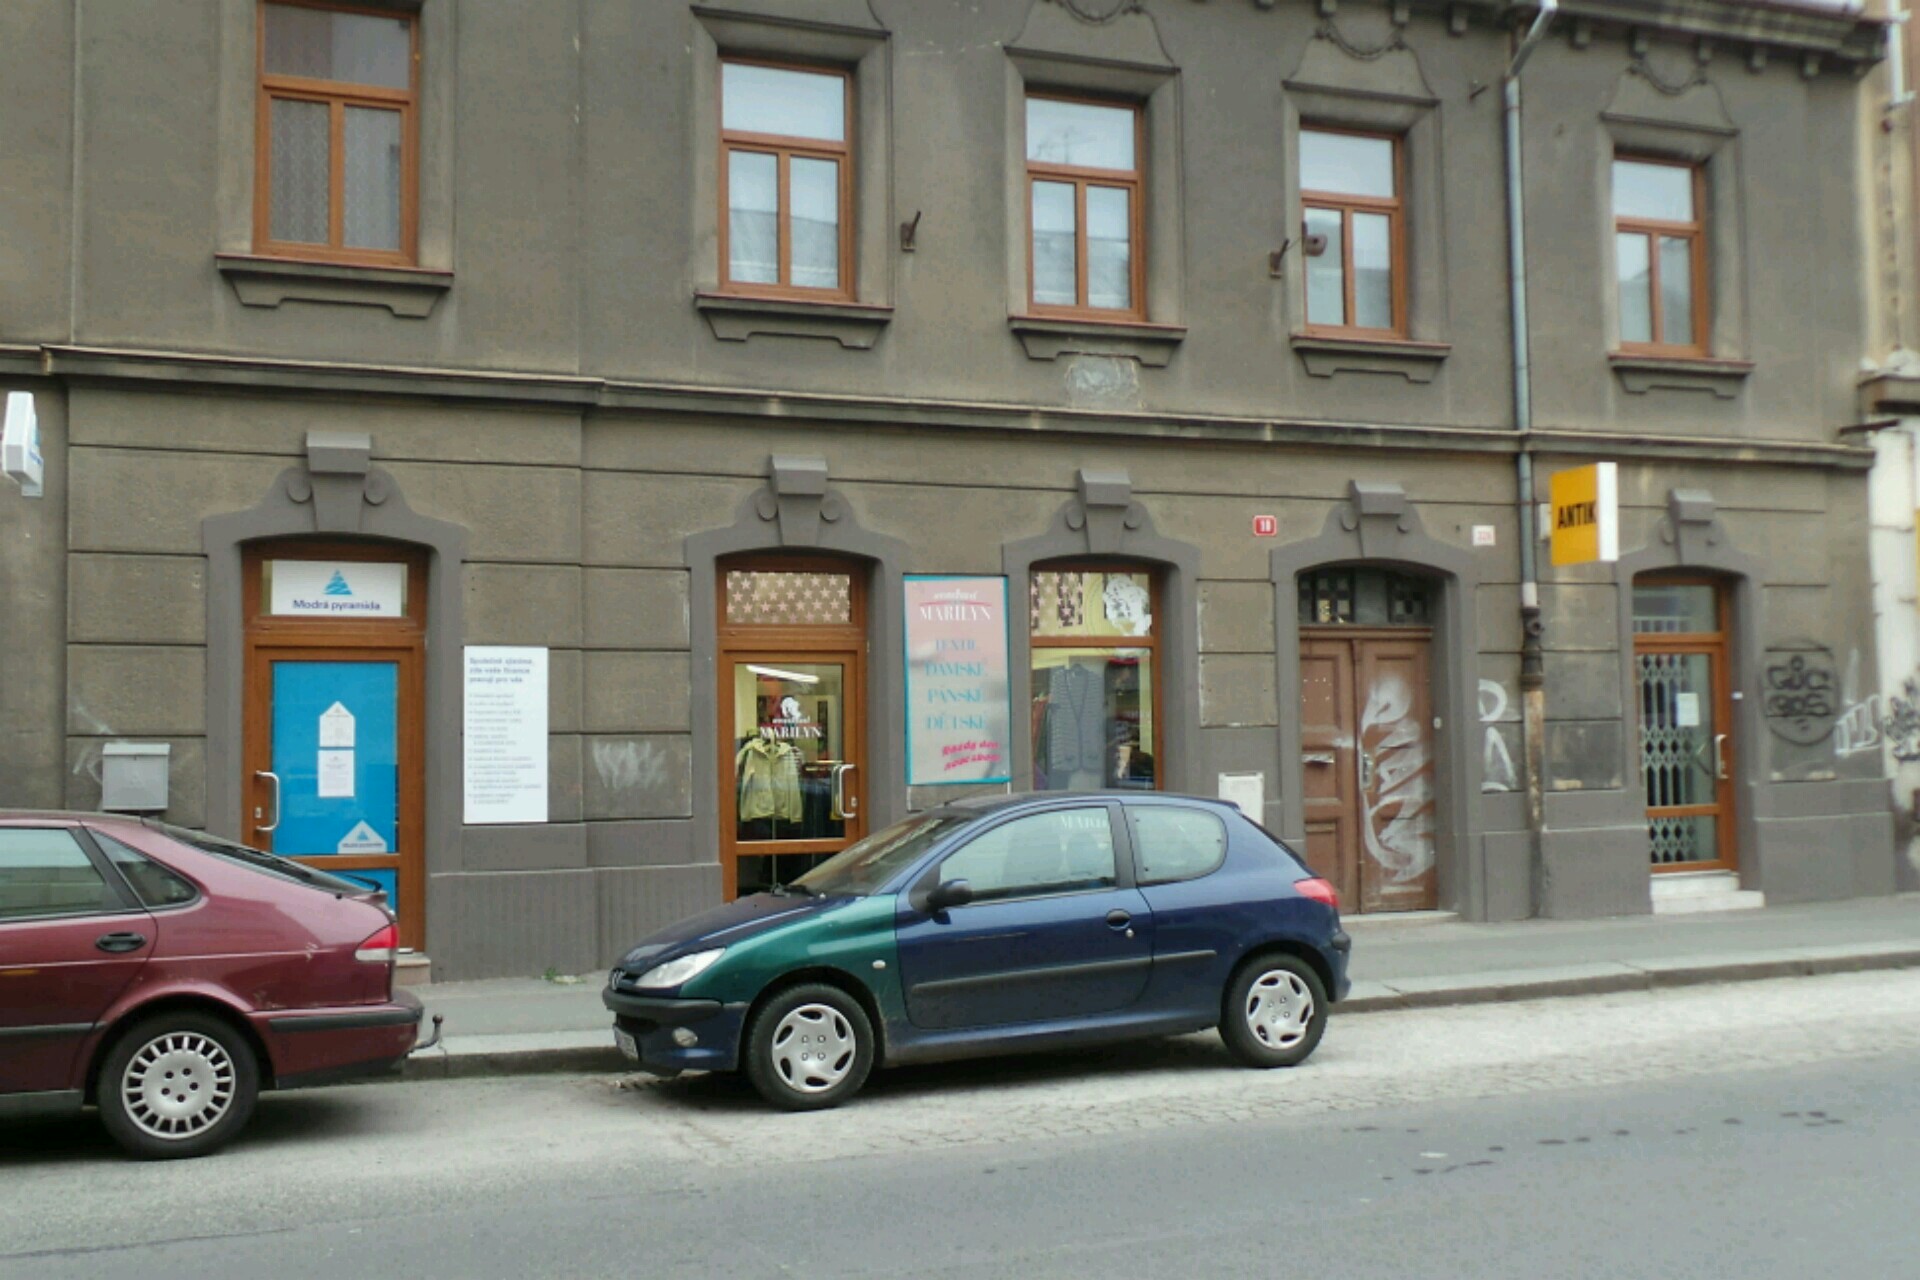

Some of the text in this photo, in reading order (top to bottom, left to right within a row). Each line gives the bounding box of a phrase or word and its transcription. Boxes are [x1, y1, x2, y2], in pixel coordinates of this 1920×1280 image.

[1557, 501, 1597, 530] ANTIK
[293, 599, 381, 612] Modrá pyramida
[919, 604, 992, 621] MARILYN
[760, 726, 822, 738] MARILYN
